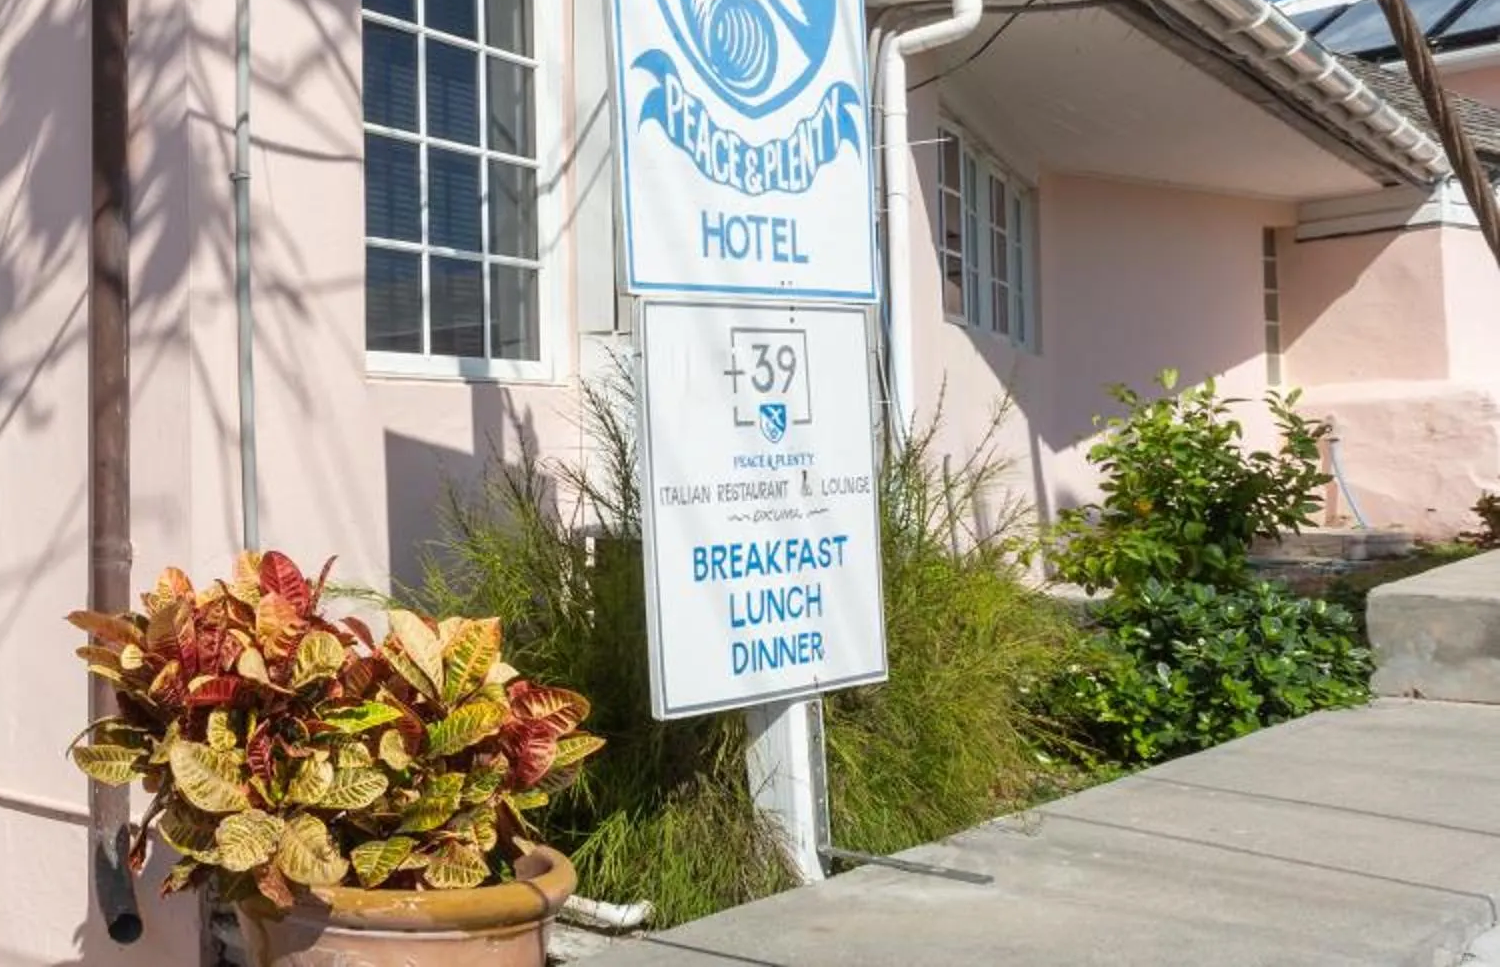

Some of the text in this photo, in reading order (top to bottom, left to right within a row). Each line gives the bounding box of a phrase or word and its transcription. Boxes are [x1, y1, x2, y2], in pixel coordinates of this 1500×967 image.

[664, 74, 840, 194] PEACE & PLENTY
[701, 210, 809, 263] HOTEL
[776, 454, 814, 466] PLENTY
[659, 486, 712, 506] ITALIAN
[717, 481, 789, 502] RESTAURANT
[821, 476, 871, 496] LOUNGE
[693, 535, 849, 582] BREAKFAST
[729, 582, 823, 628] LUNCH
[731, 632, 825, 676] DINNER
